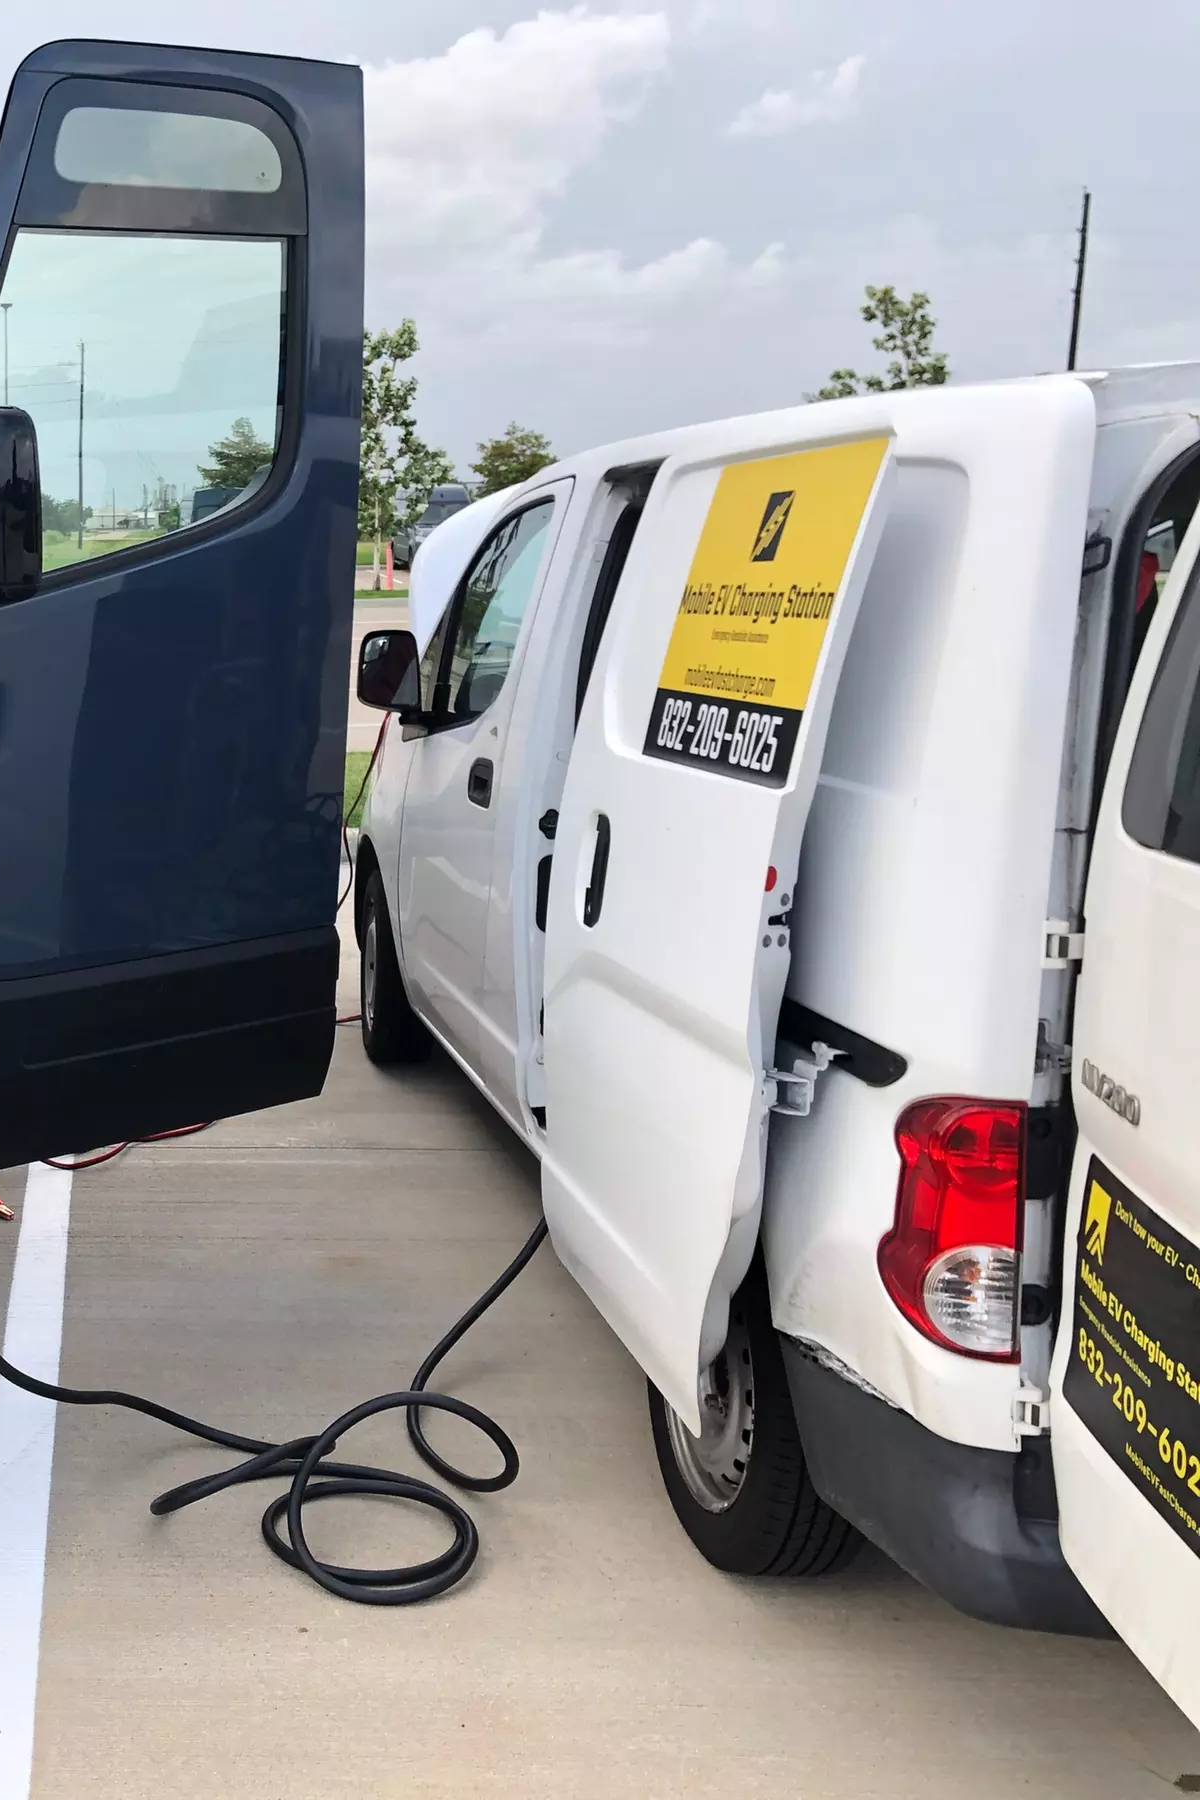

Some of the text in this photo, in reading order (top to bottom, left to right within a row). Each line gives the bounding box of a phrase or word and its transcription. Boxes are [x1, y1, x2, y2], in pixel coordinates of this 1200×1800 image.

[678, 582, 836, 624] Mobile EV Charging Station
[657, 698, 784, 773] 832-209-6025
[1115, 1200, 1133, 1228] Don't
[1132, 1218, 1147, 1240] tow
[1146, 1233, 1166, 1256] your
[1164, 1245, 1179, 1267] EV
[1080, 1258, 1108, 1307] Mobile
[1107, 1291, 1123, 1322] EV
[1123, 1310, 1175, 1381] Charging
